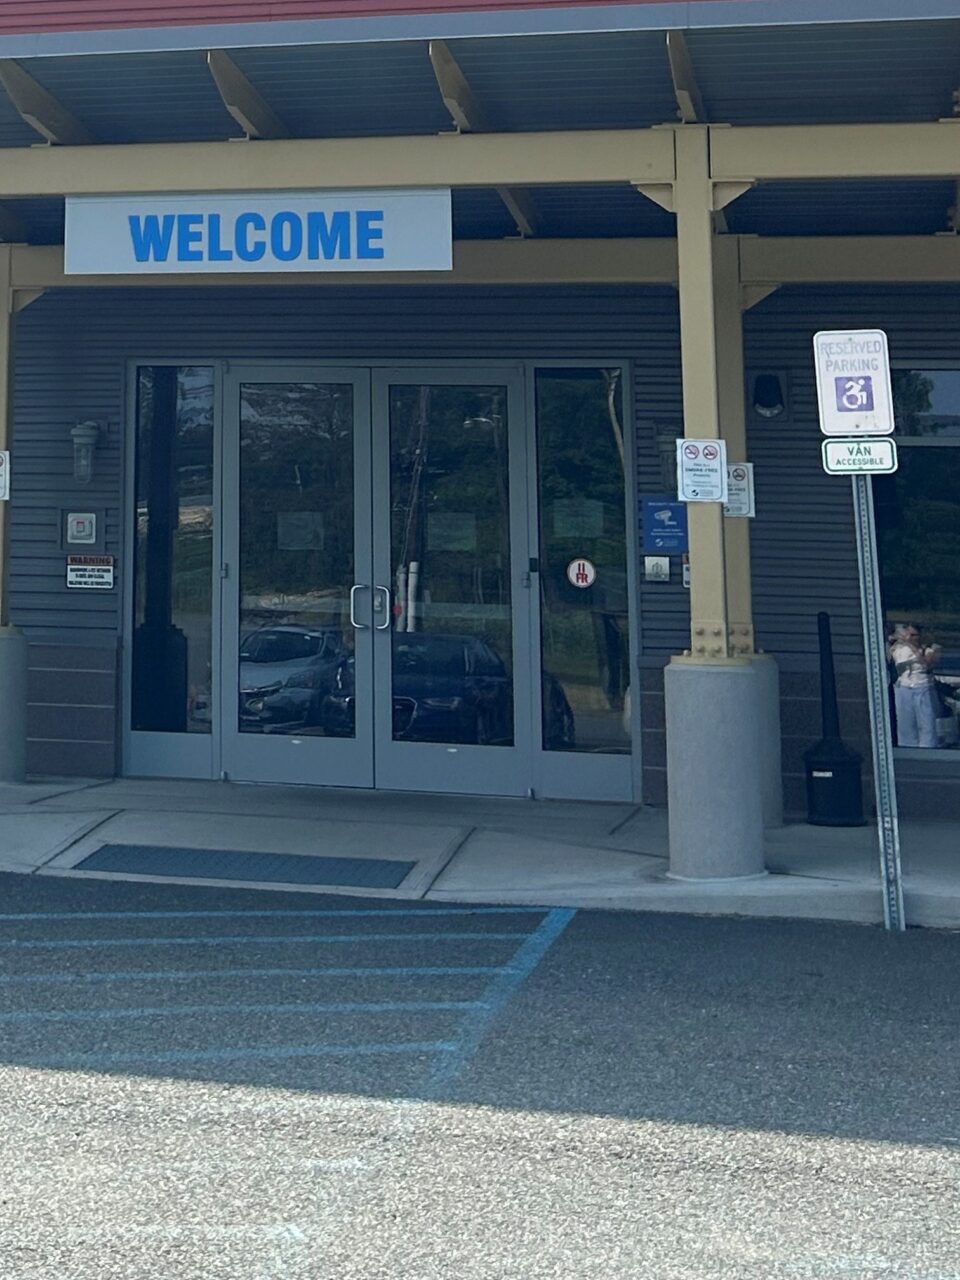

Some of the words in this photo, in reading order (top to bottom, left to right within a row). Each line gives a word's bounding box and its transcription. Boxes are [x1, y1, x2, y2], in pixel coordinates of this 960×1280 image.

[128, 210, 385, 262] WELCOME
[820, 340, 881, 357] RESERVED
[825, 358, 879, 372] PARKING
[847, 446, 872, 457] VAN
[835, 457, 885, 466] ACCESSIBLE
[69, 556, 112, 565] WARNING
[576, 573, 589, 584] FR
